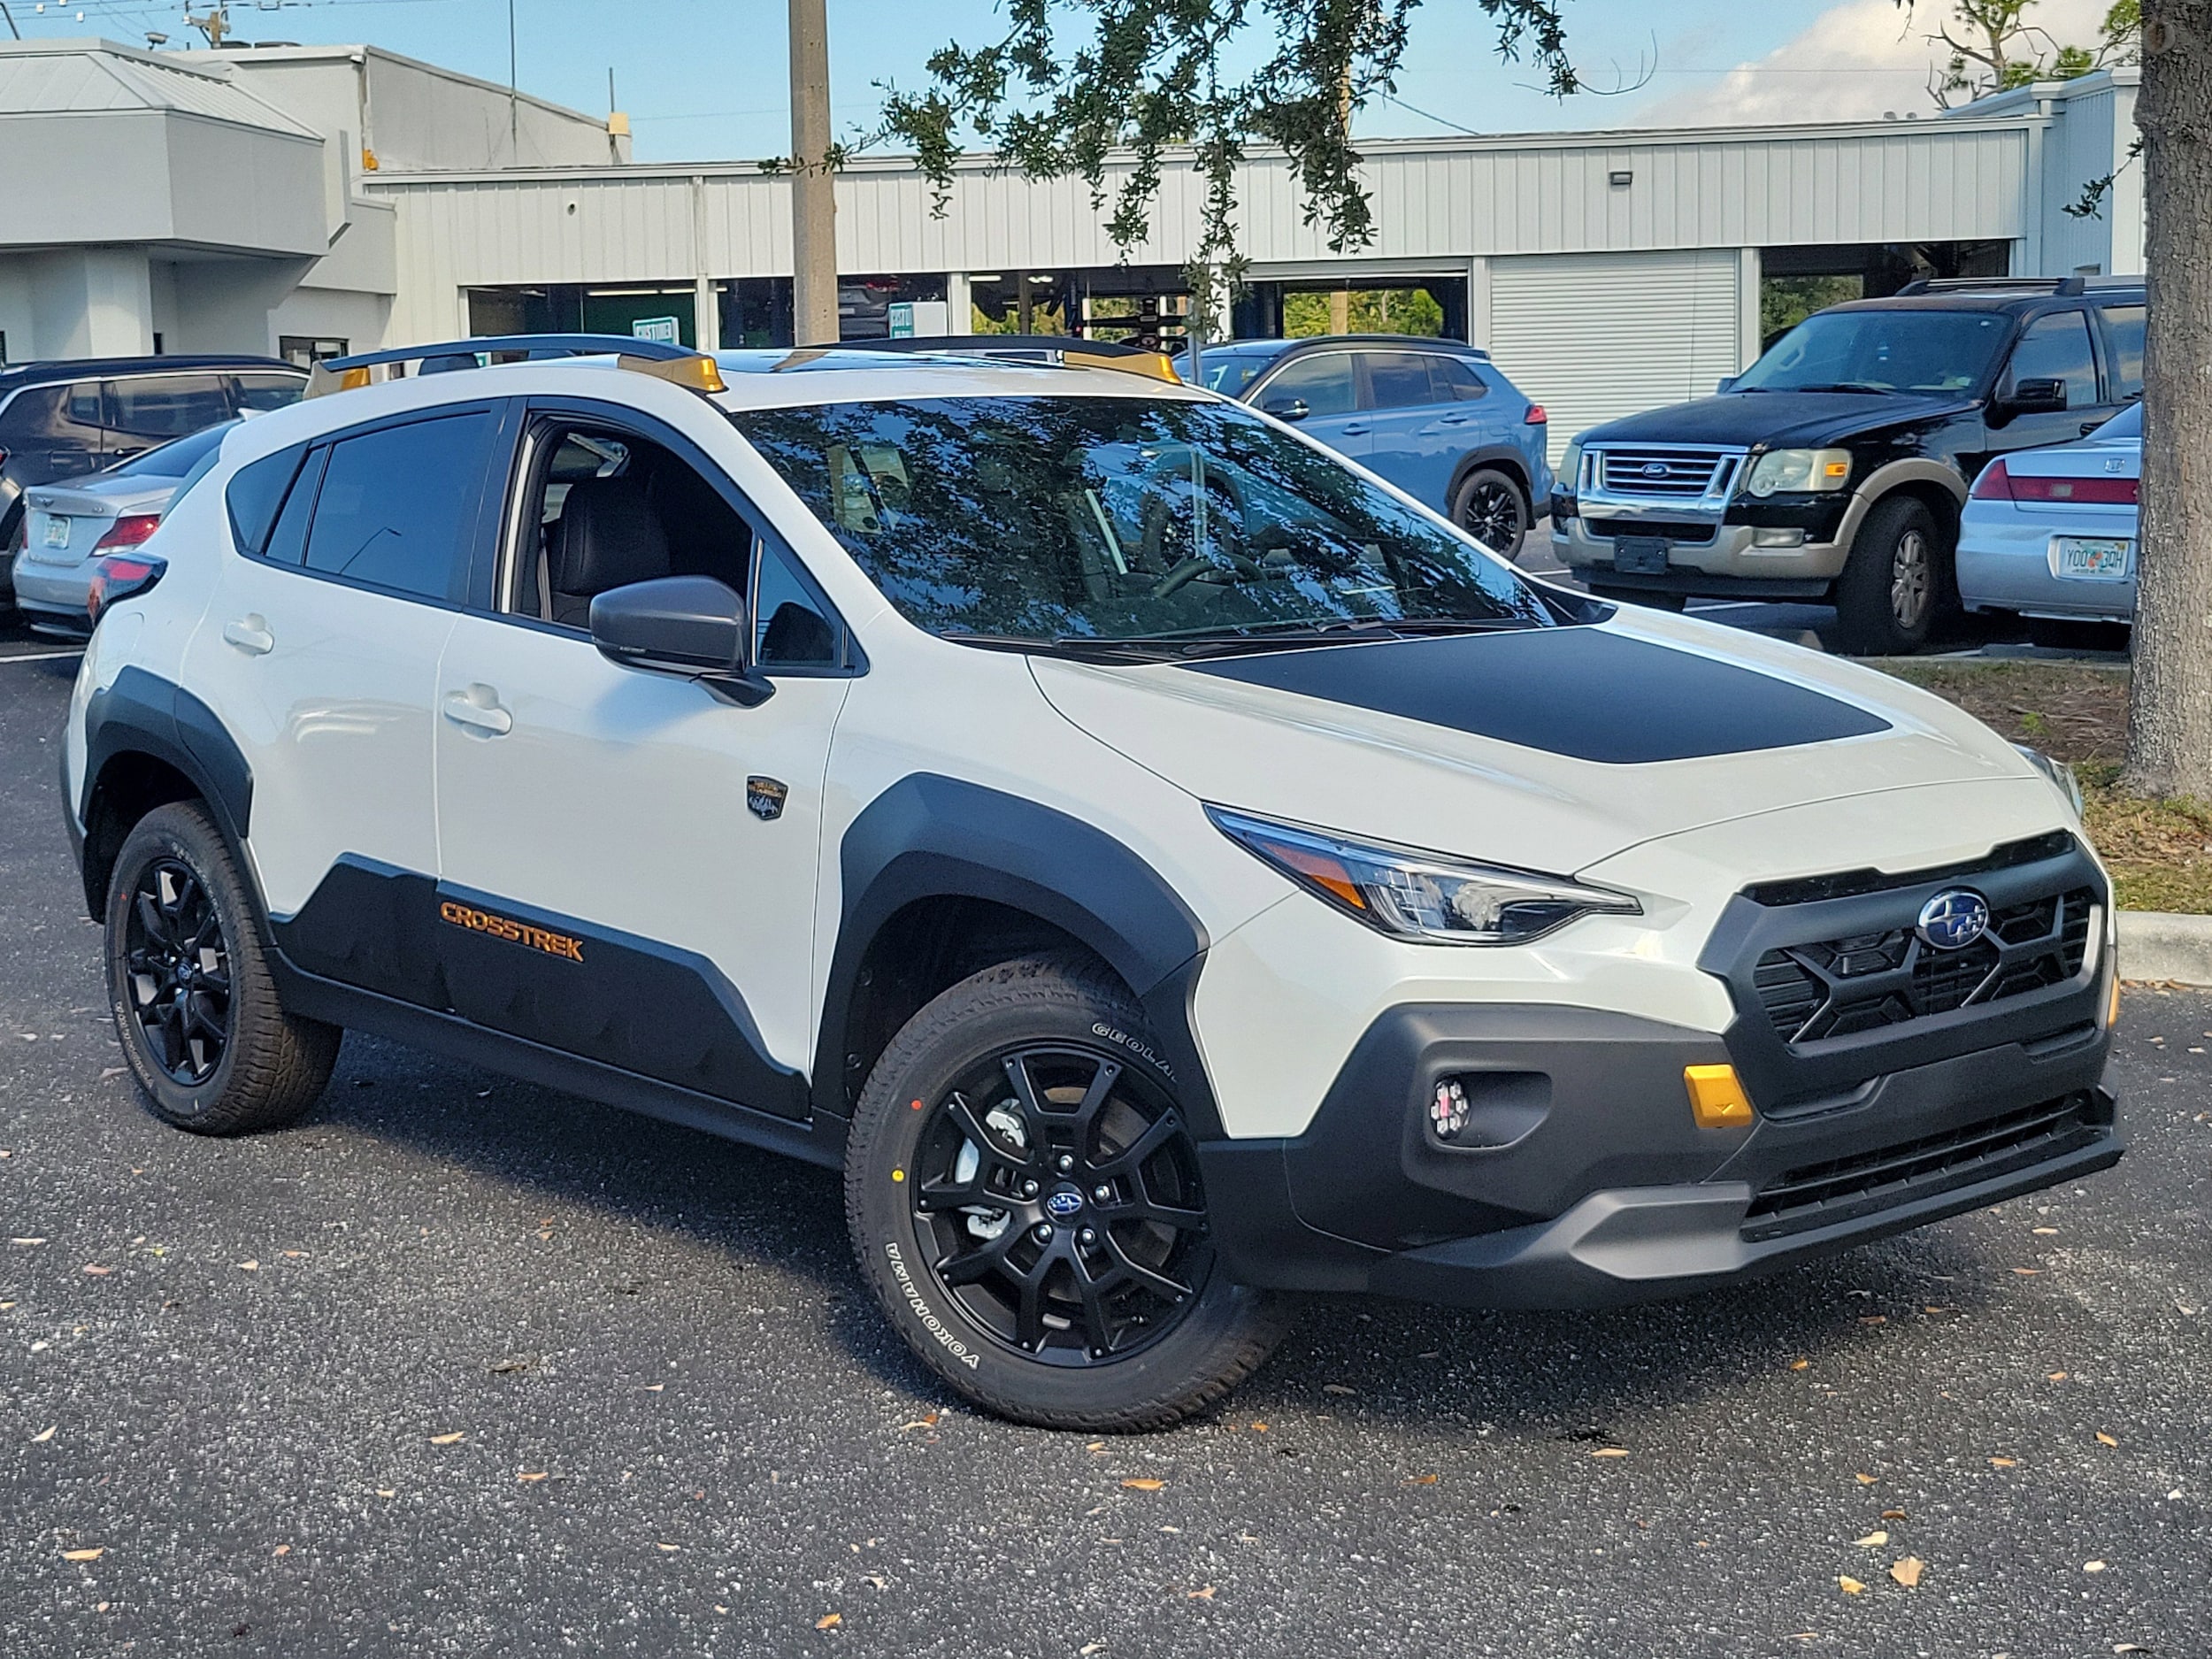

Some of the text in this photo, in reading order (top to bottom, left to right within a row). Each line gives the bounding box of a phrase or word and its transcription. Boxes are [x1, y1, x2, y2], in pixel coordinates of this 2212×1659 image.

[440, 901, 585, 963] CROSSTREK
[1091, 1022, 1177, 1083] GEOLA
[885, 1241, 980, 1371] YOKOHAMA
